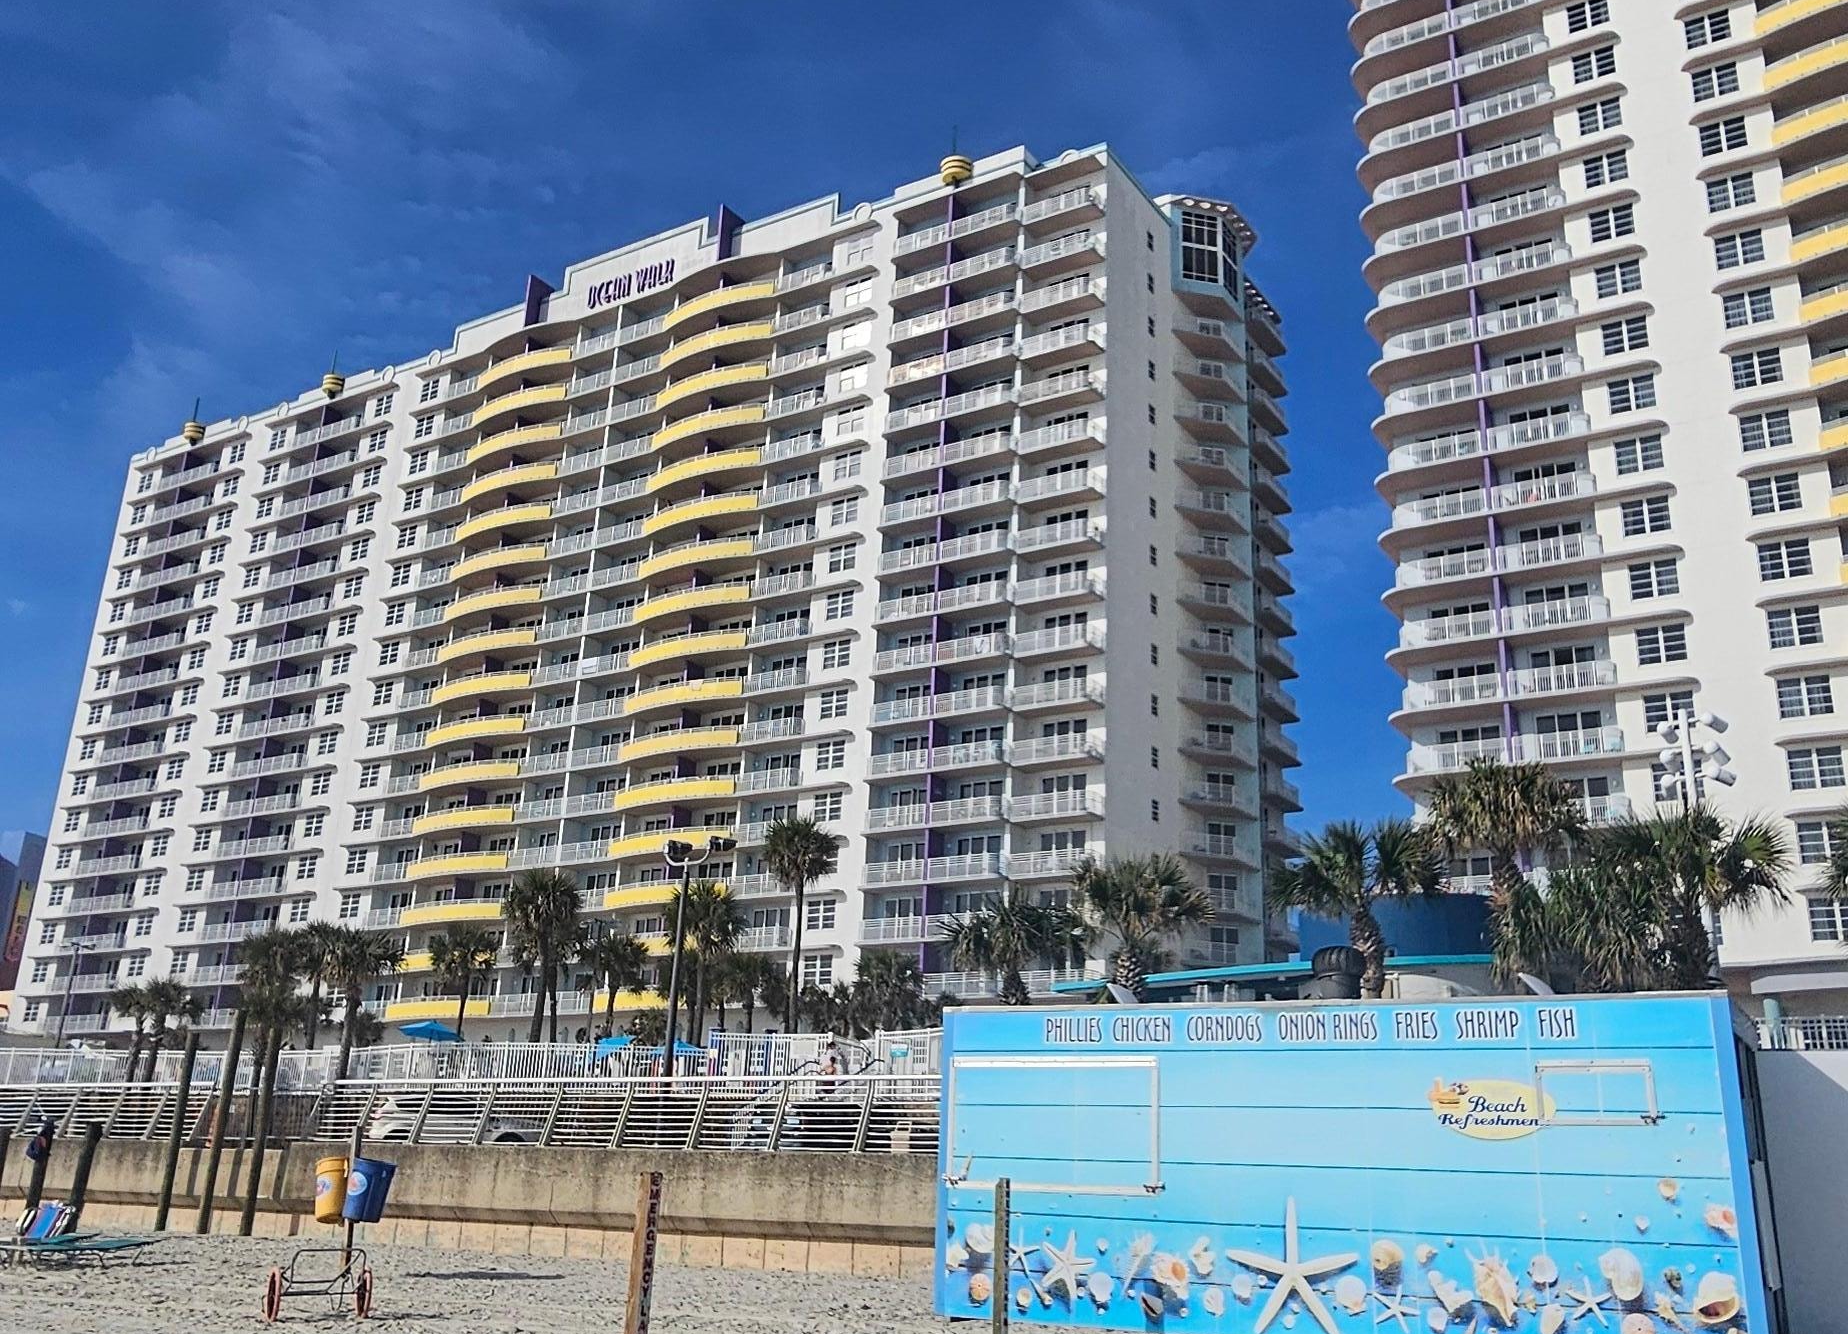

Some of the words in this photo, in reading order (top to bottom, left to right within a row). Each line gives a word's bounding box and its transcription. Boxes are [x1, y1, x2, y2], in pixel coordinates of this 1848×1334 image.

[587, 272, 632, 309] OCEAN
[635, 258, 675, 293] WALK
[1046, 1017, 1102, 1043] PHILLIES
[1112, 1016, 1171, 1042] CHICKEN
[1186, 1015, 1263, 1042] CORNDOGS
[1278, 1013, 1326, 1041] ONION
[1333, 1012, 1378, 1040] RINGS
[1395, 1011, 1438, 1040] FRIES
[1456, 1010, 1519, 1040] SHRIMP
[1538, 1009, 1576, 1039] FISH
[1468, 1095, 1527, 1113] Beach
[642, 1174, 662, 1298] EMERGENCY
